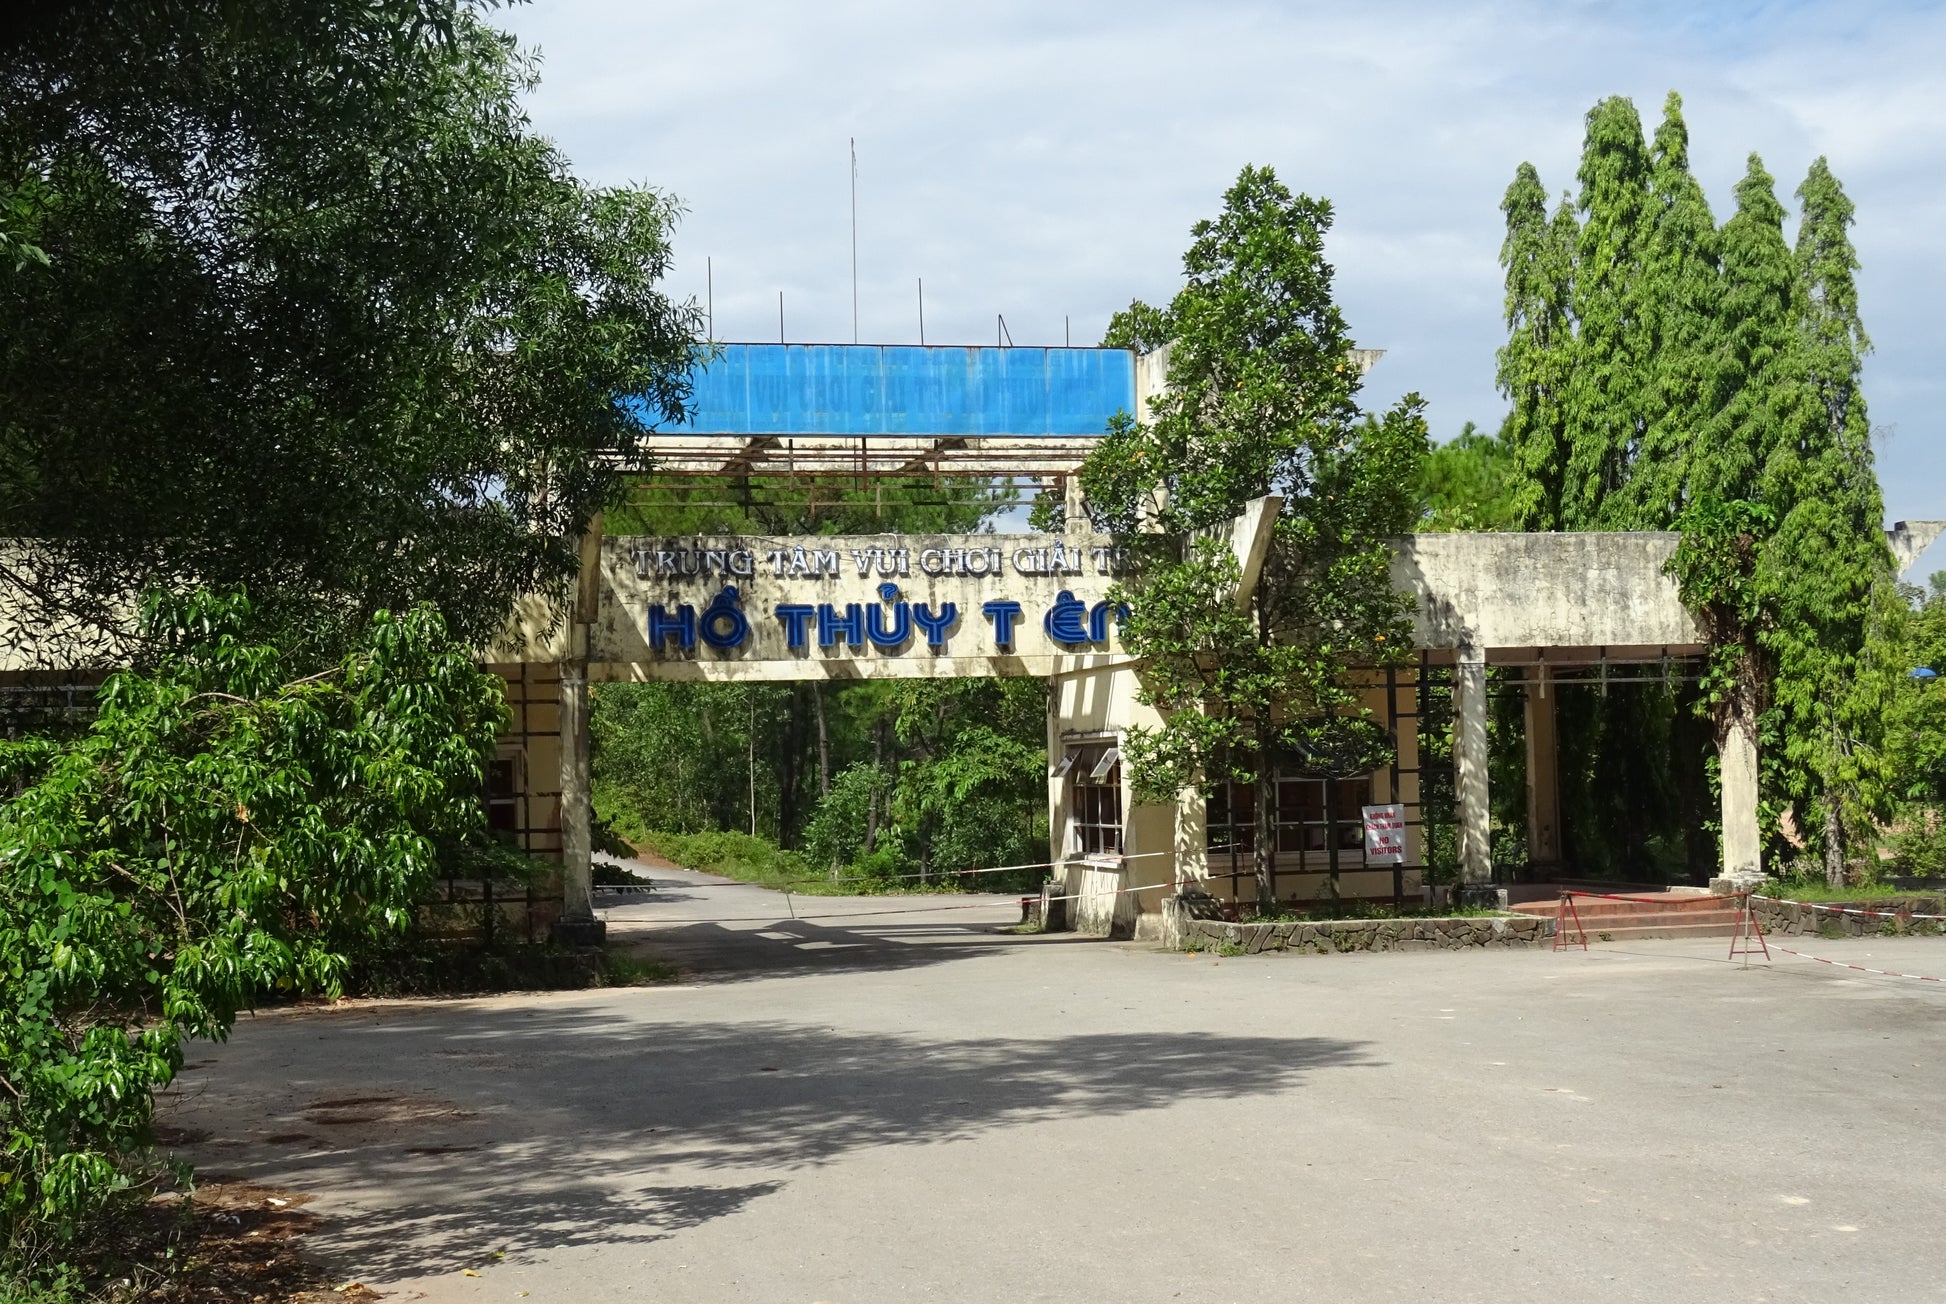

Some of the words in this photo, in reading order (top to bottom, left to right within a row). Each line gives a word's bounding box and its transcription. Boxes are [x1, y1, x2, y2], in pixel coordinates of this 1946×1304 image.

[631, 549, 754, 577] TRUNG
[767, 545, 840, 576] TÂM
[850, 548, 910, 575] VUI
[920, 547, 1003, 575] CHƠI
[1012, 538, 1082, 574] GIẢI
[1090, 546, 1135, 573] TR
[775, 582, 957, 648] THỦY
[1370, 846, 1402, 856] VISITORS
